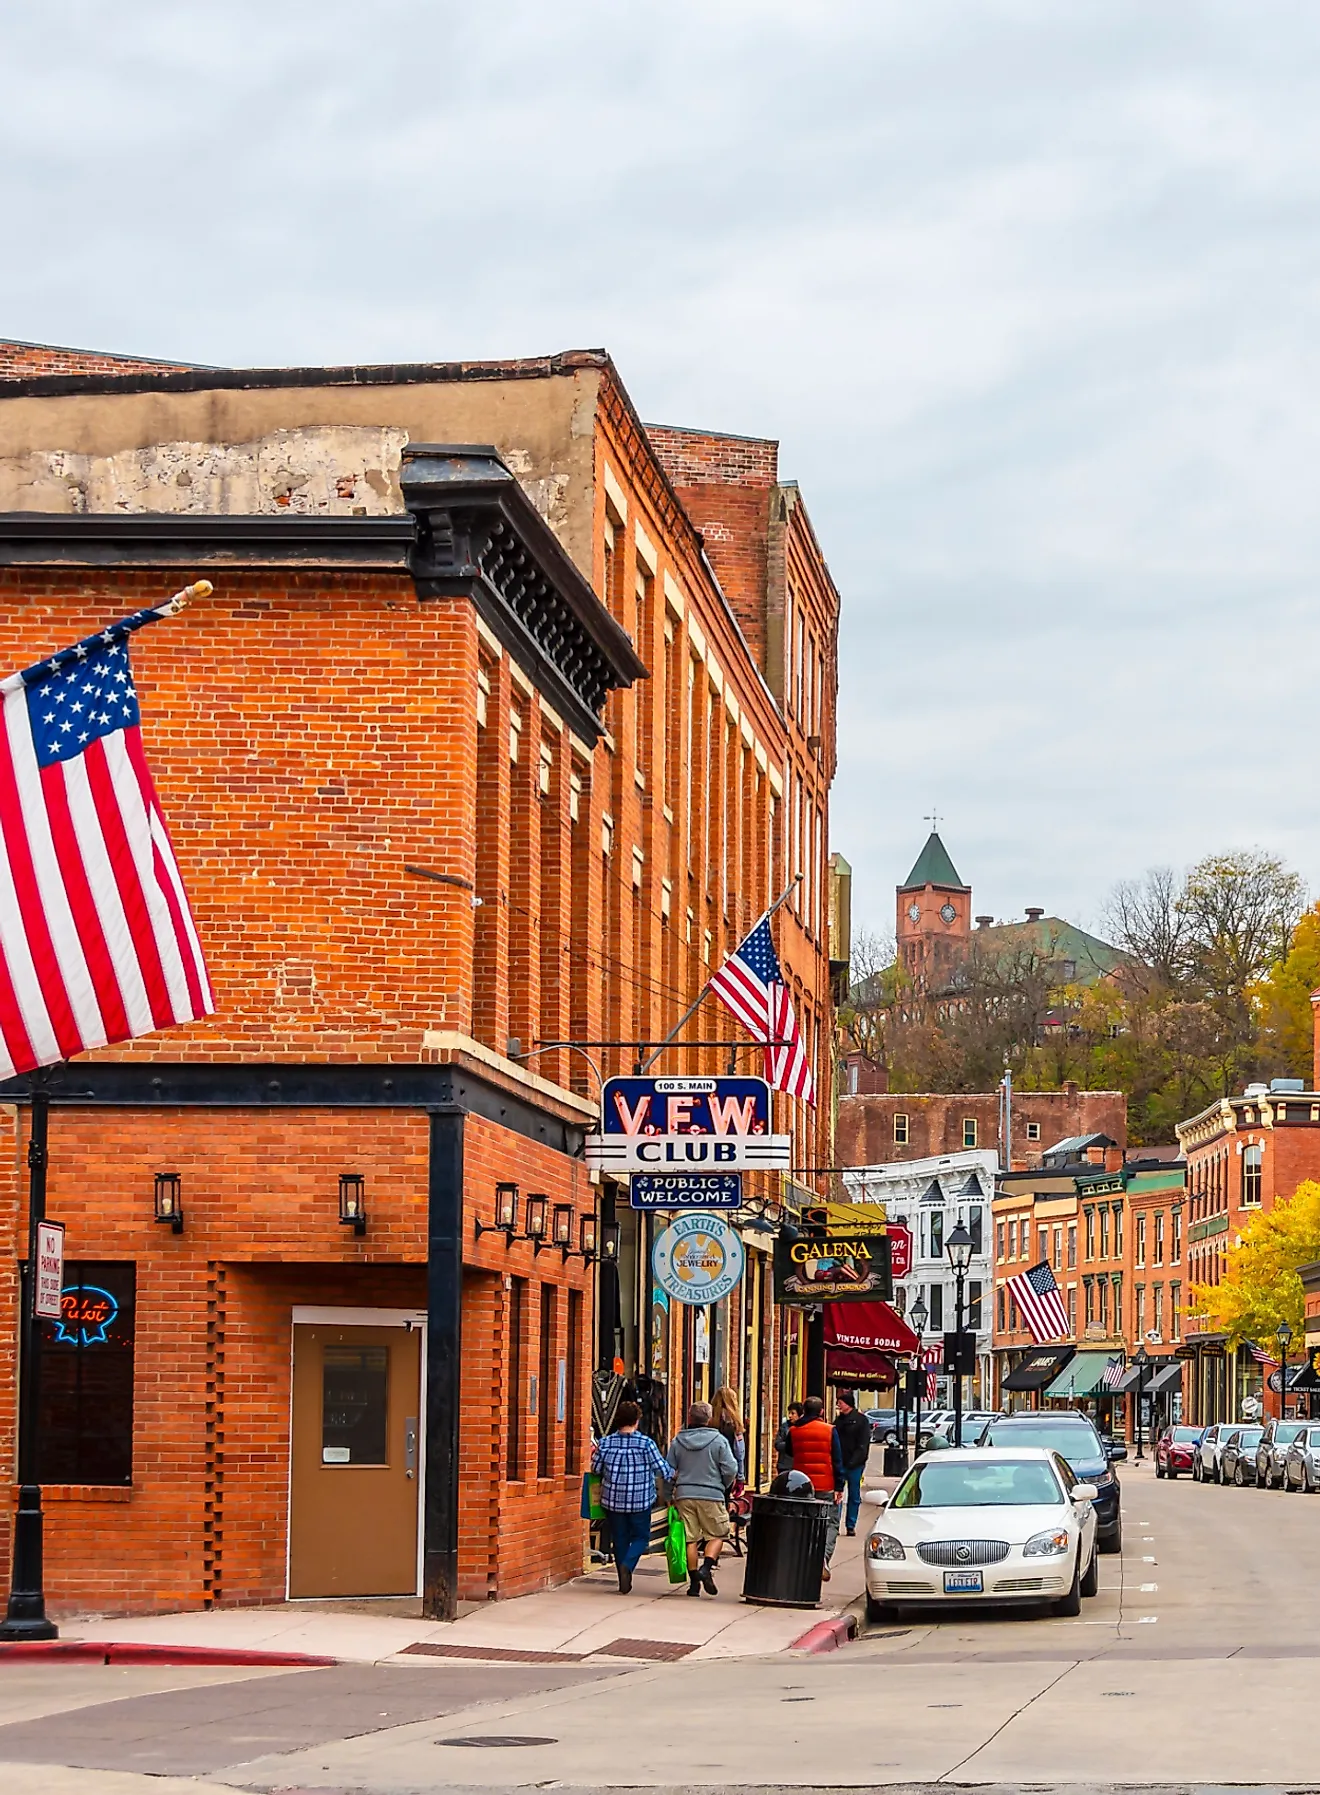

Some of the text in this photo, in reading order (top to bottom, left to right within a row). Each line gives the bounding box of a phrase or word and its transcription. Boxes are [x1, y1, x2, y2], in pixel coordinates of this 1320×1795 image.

[658, 1082, 713, 1090] 100 S. MAIN
[635, 1142, 737, 1162] CLUB
[652, 1177, 720, 1189] PUBLIC
[640, 1191, 732, 1203] WELCOME
[673, 1218, 726, 1236] EARTH'S
[46, 1236, 55, 1254] NO
[790, 1241, 873, 1264] GALENA
[41, 1254, 60, 1274] PARKING
[676, 1259, 719, 1268] JEWELRY
[663, 1272, 733, 1301] TREASURES
[836, 1333, 901, 1348] VINTAGE SODAS
